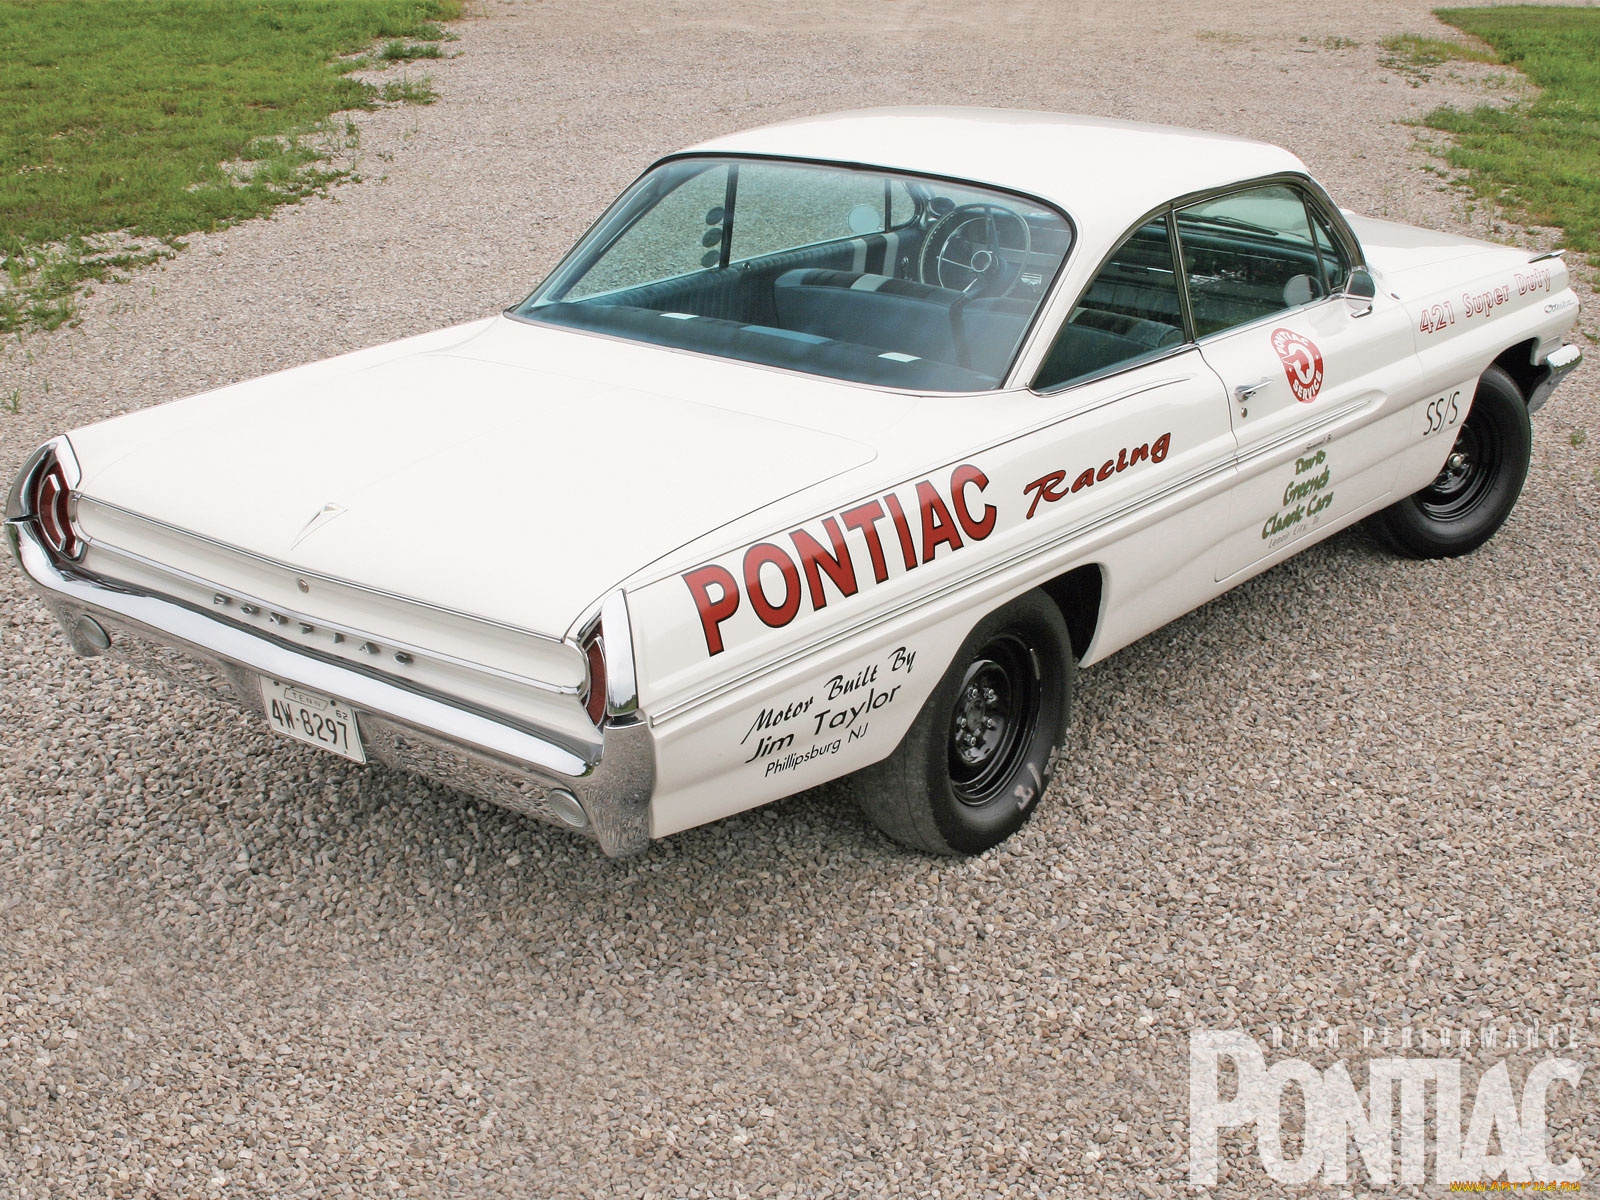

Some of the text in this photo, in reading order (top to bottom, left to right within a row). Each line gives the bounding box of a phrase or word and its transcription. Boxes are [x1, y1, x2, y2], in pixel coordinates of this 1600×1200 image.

[1419, 300, 1455, 334] 421
[1462, 283, 1510, 318] Super
[1513, 267, 1551, 296] Duty
[1273, 330, 1310, 356] PONTIAC
[1292, 369, 1322, 401] SERVICE
[1423, 391, 1460, 436] SS/S
[1023, 431, 1172, 520] Racing
[1306, 491, 1335, 518] Cars
[680, 463, 998, 657] PONTIAC
[213, 593, 415, 666] PONTIAC
[335, 709, 349, 721] 62
[739, 646, 917, 746] Motor Built By
[744, 684, 902, 764] Jim Taylor
[764, 722, 869, 778] Phillipsburg NJ
